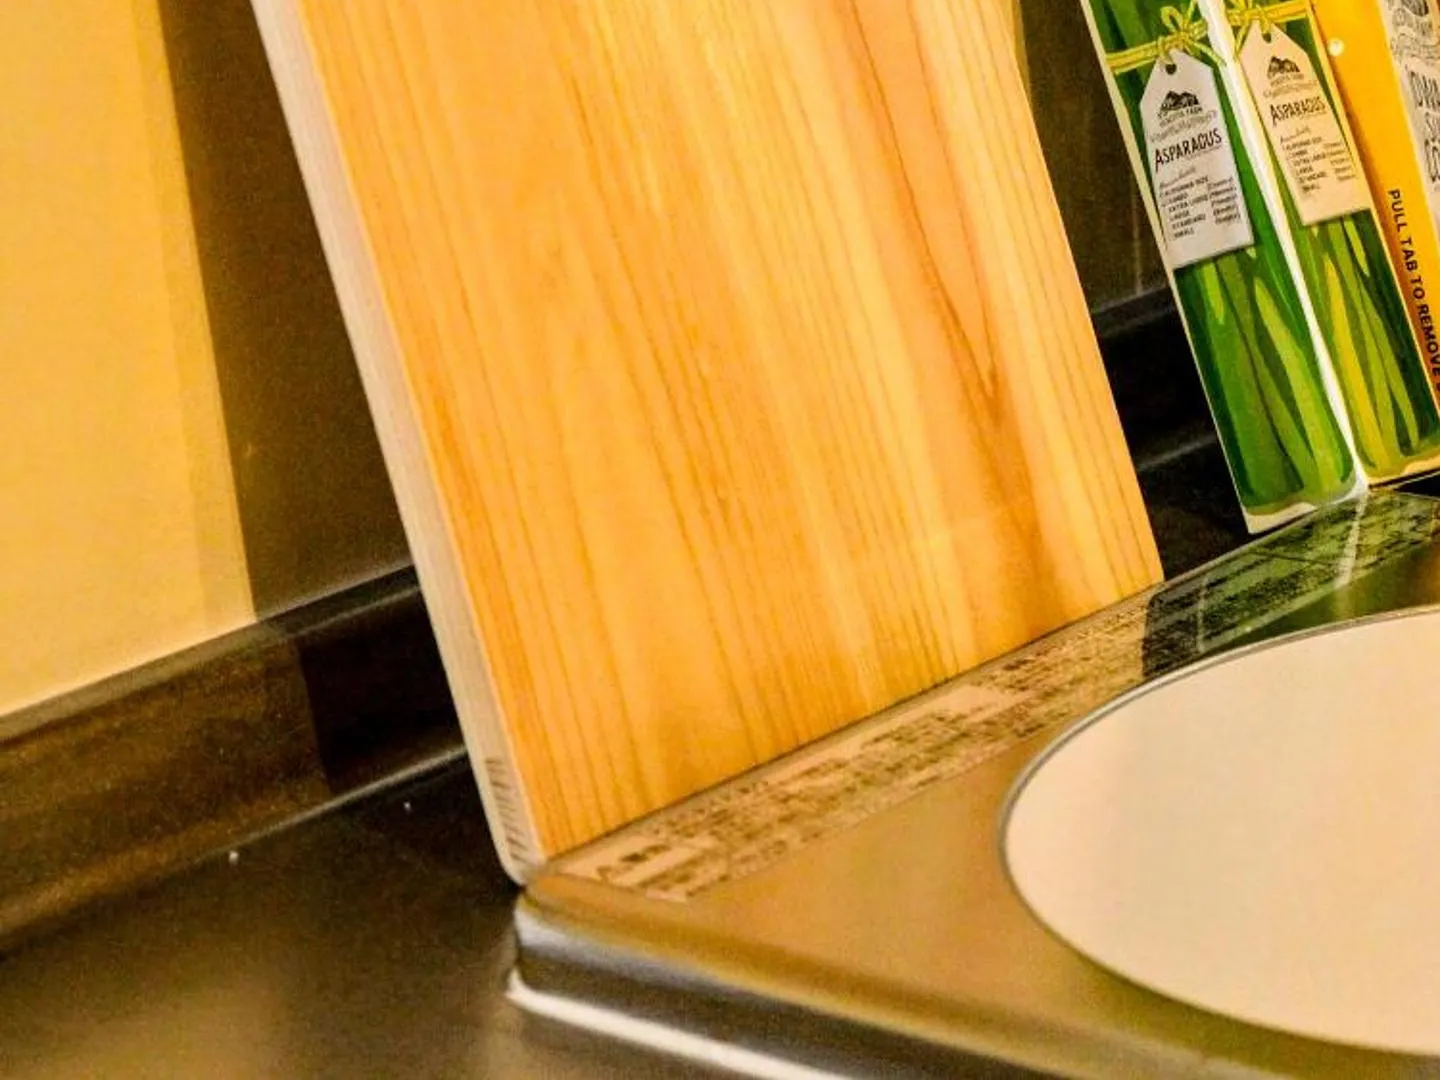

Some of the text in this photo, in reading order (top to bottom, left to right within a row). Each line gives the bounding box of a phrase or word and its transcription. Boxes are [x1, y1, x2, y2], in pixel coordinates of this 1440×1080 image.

[1270, 96, 1326, 127] ASPARAGUS
[1155, 127, 1222, 172] ASPARAGUS
[1388, 189, 1407, 233] PULL
[1401, 237, 1418, 272] TAB
[1411, 276, 1425, 299] TO
